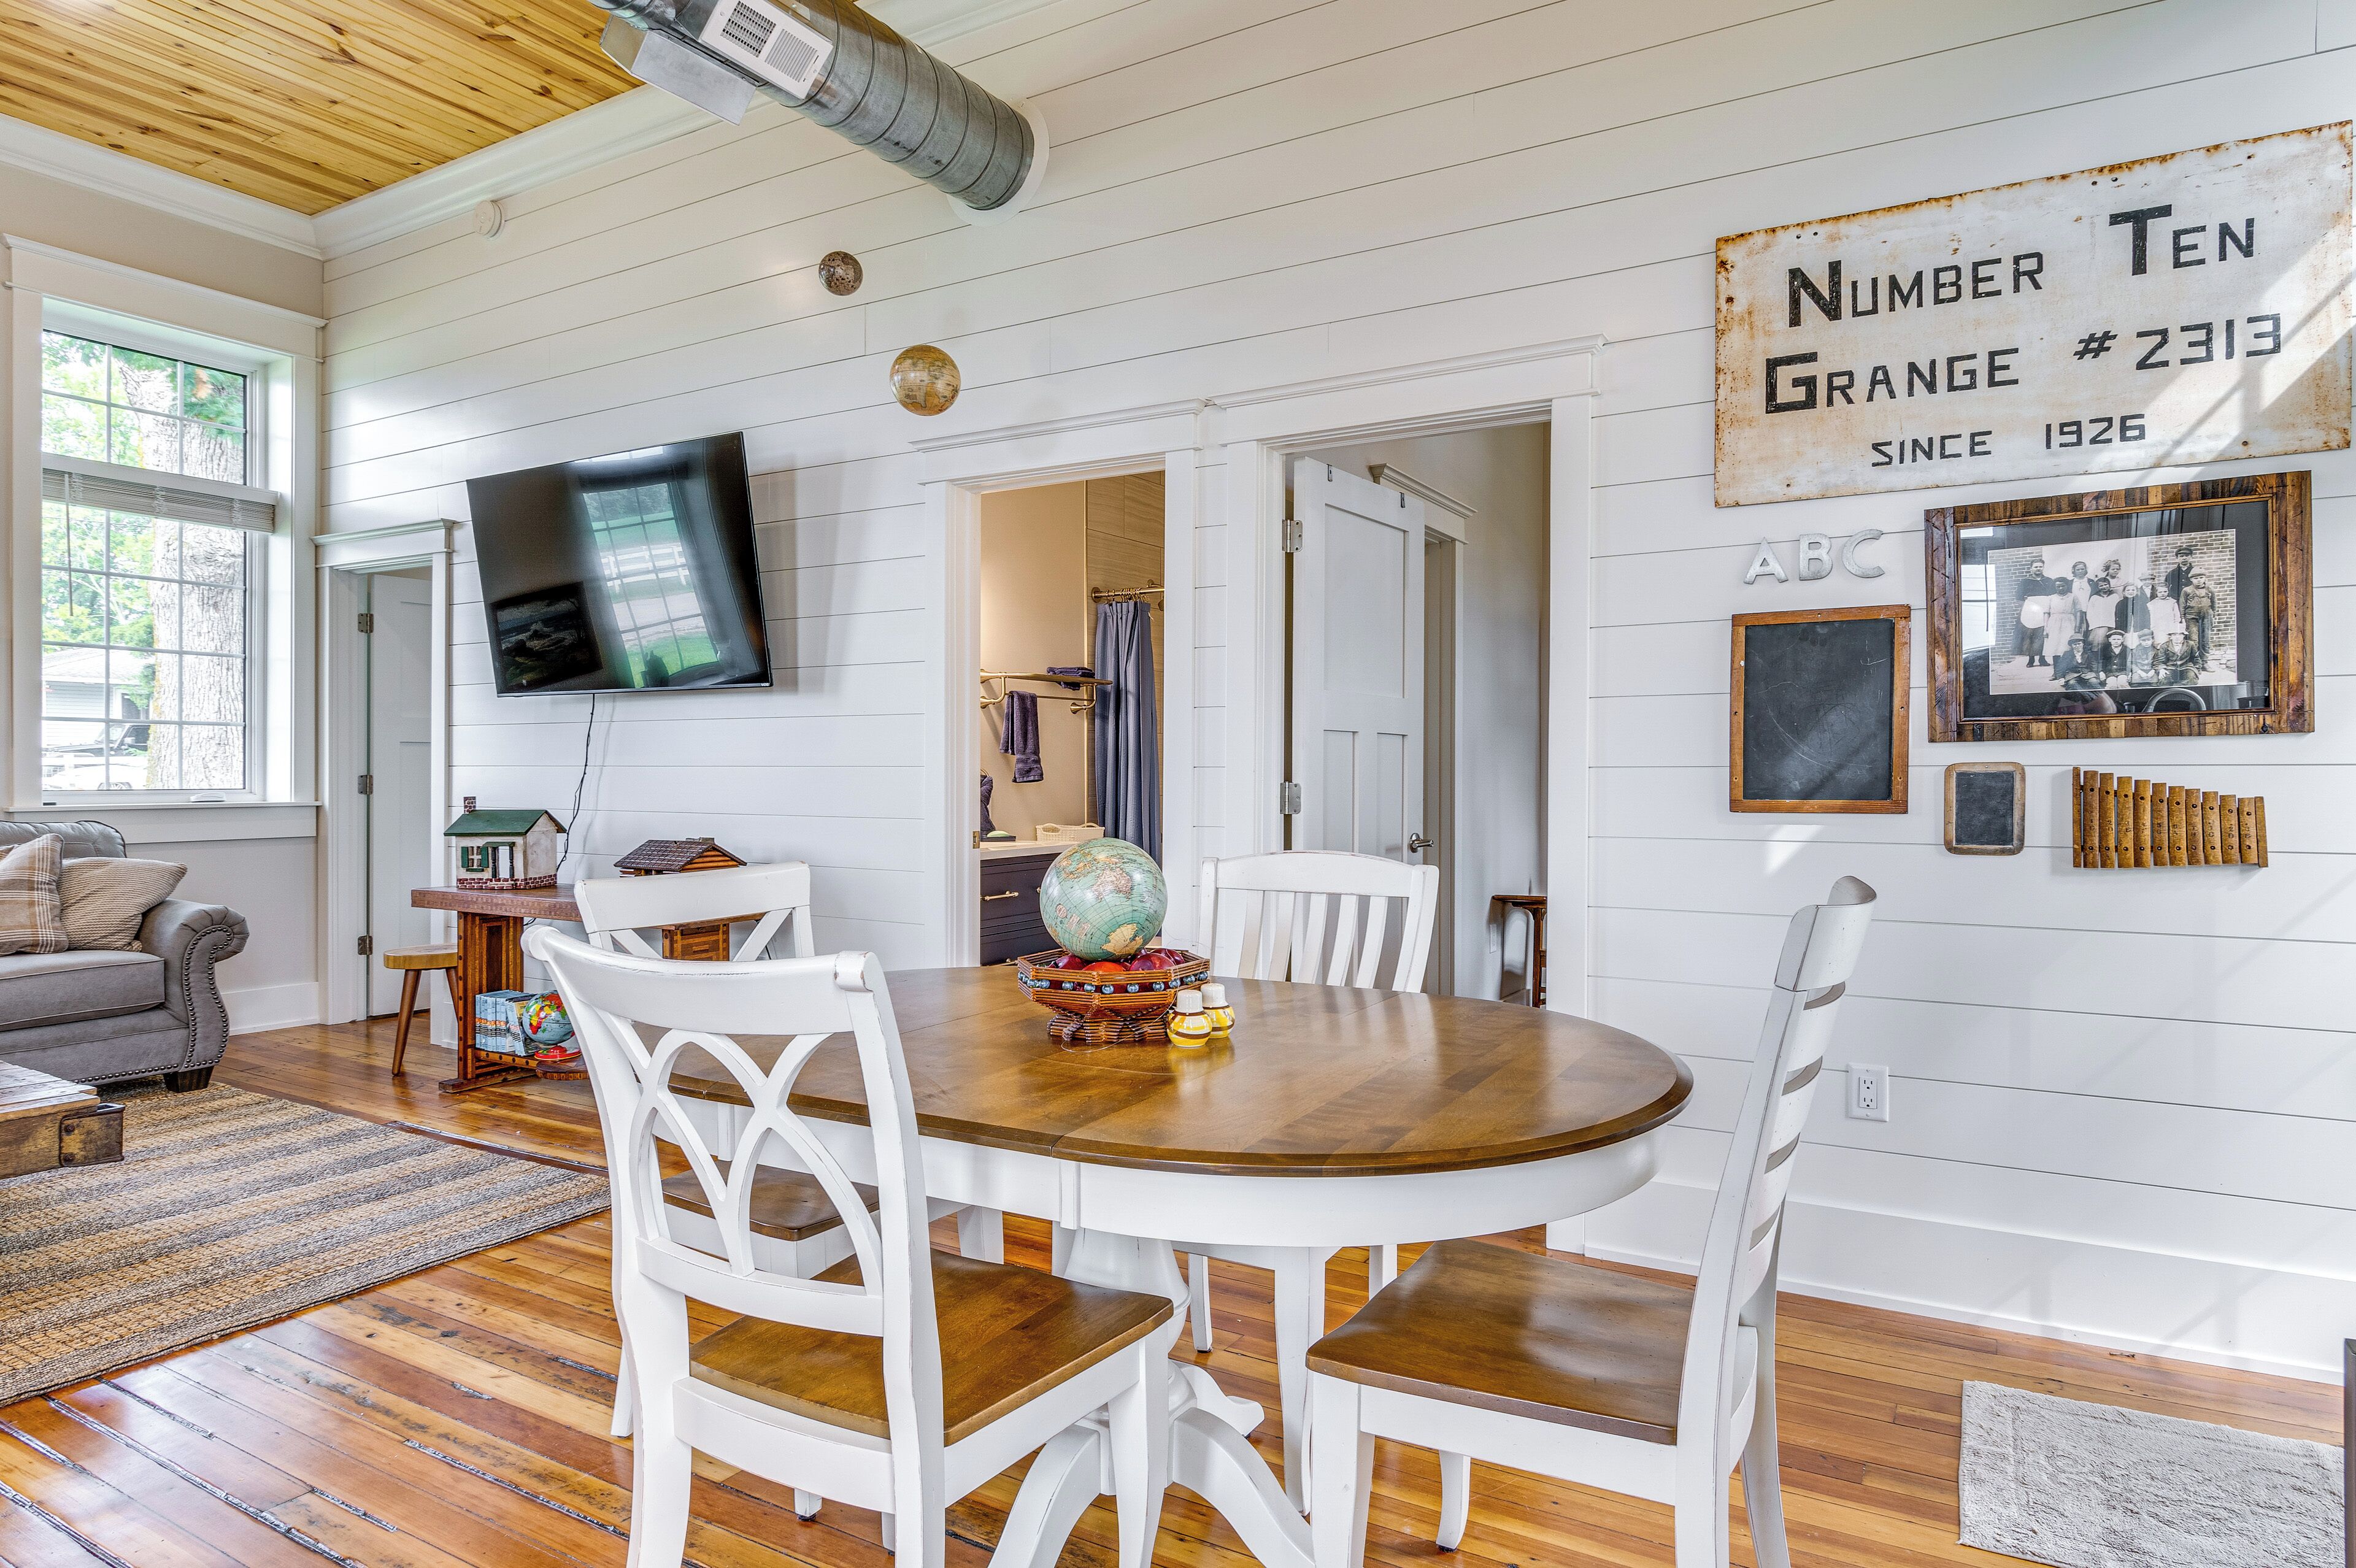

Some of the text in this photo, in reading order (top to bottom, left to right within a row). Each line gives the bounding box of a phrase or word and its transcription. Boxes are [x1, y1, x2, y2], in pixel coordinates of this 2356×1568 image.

[1788, 204, 2255, 328] NUMBER TEN
[1766, 347, 2019, 414] GRANGE
[1872, 413, 2146, 467] SINCE 1926
